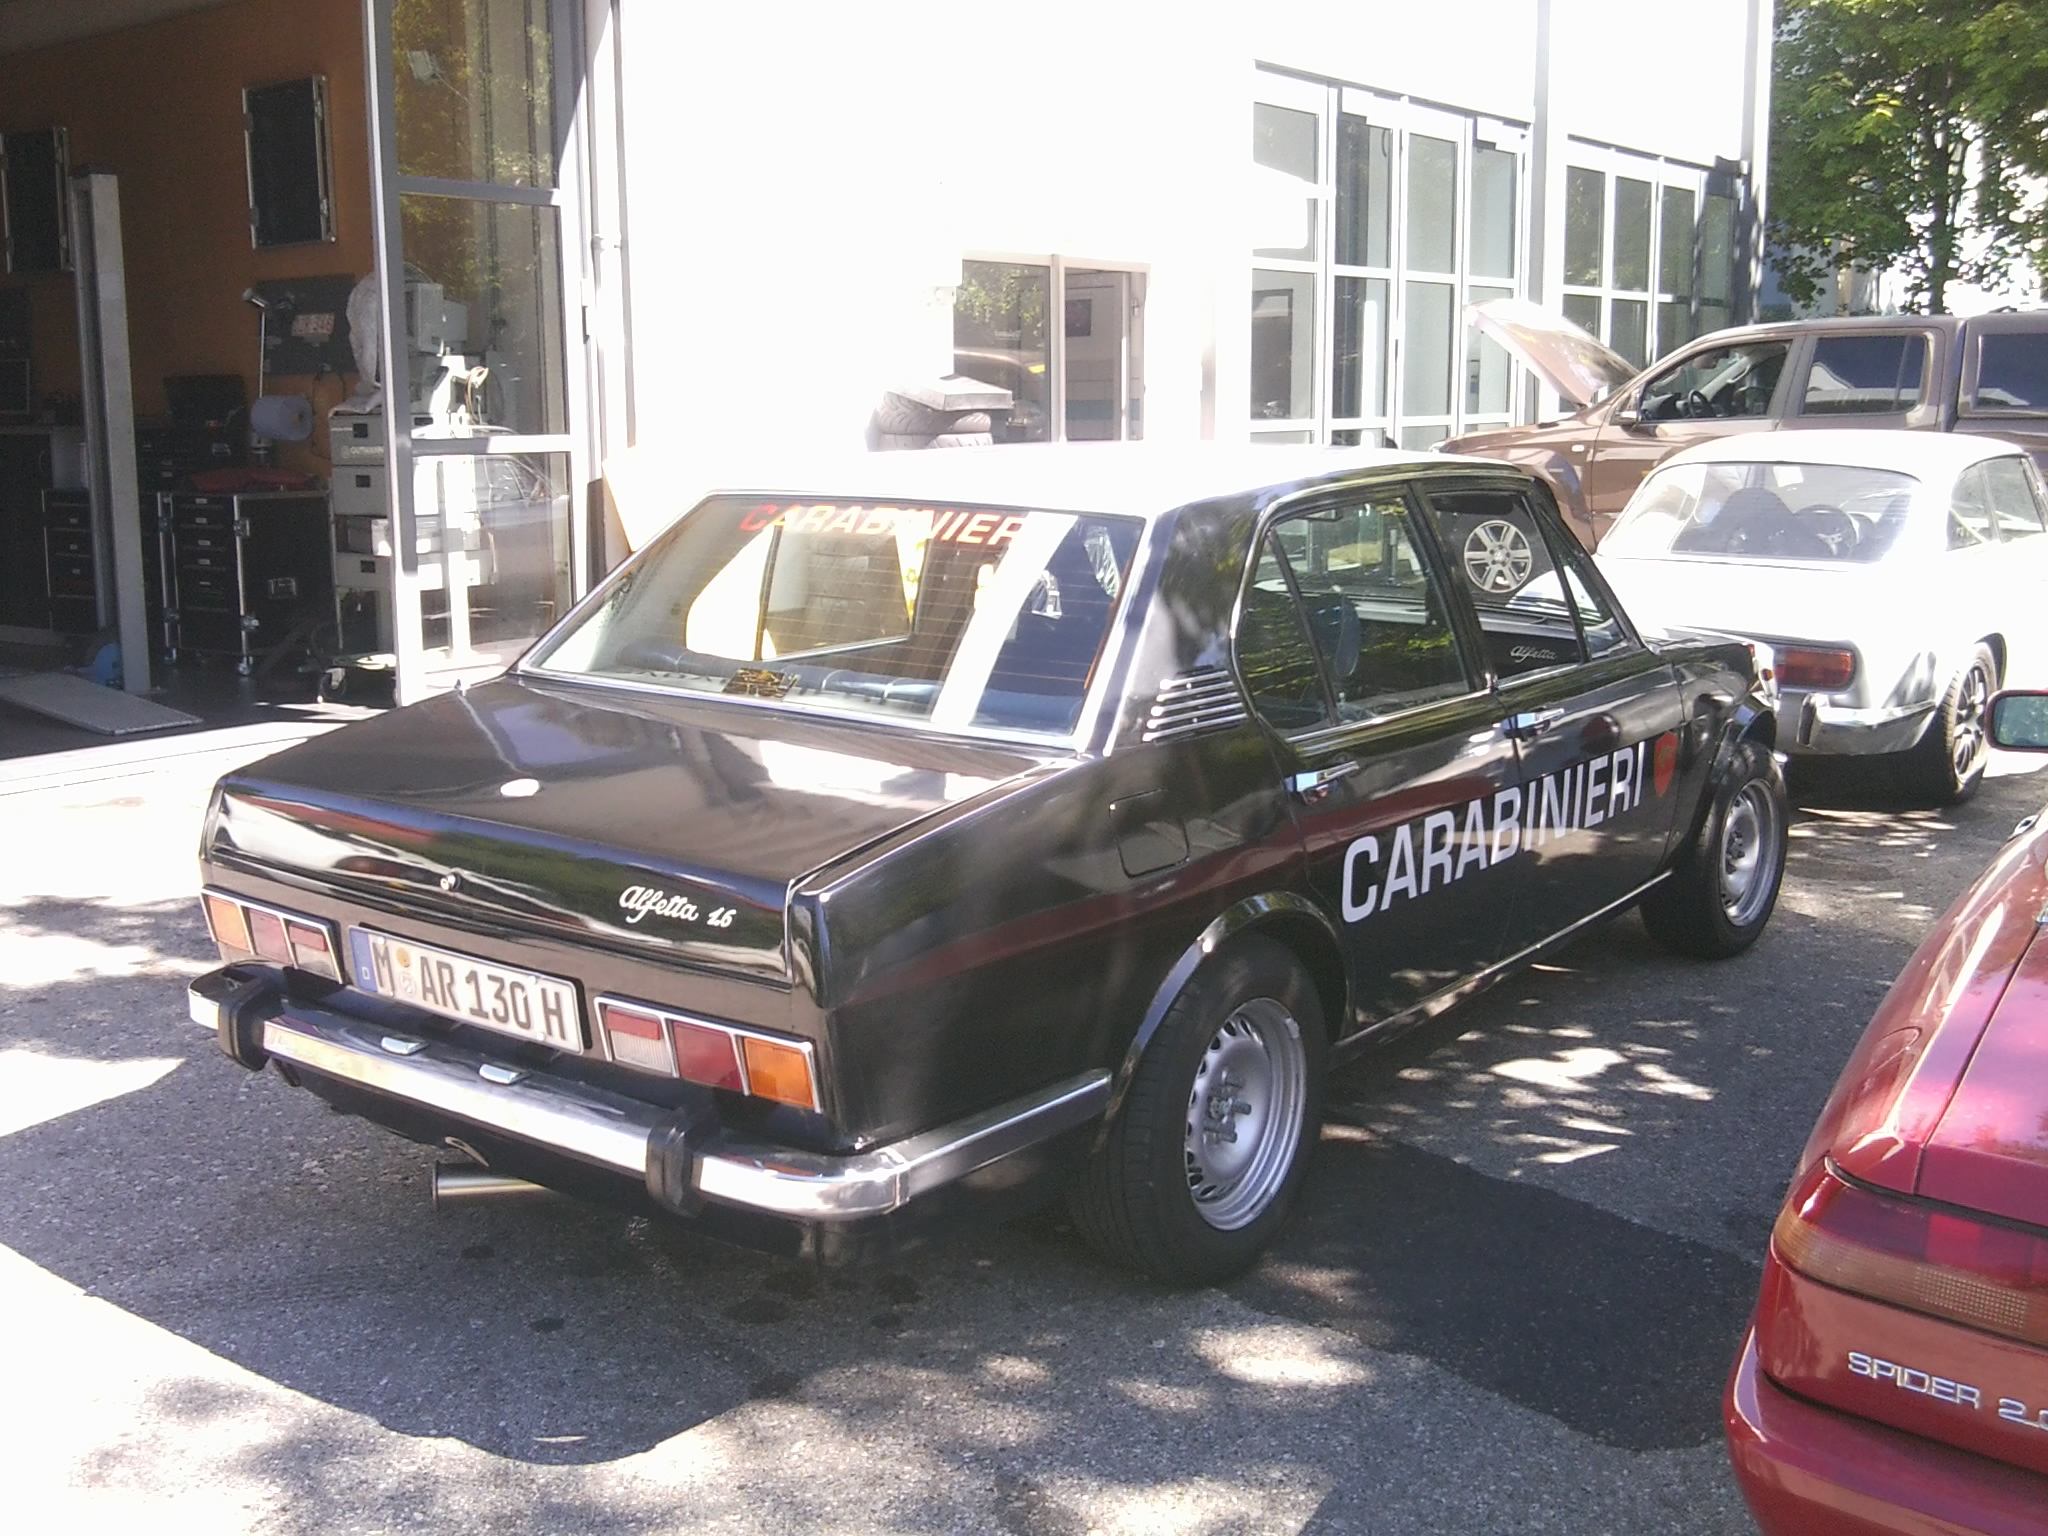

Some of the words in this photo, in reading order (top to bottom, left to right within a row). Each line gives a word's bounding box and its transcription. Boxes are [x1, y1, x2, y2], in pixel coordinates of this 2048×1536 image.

[1510, 645, 1557, 664] Alfetta
[1341, 741, 1646, 923] CARABINIERI
[619, 885, 699, 924] Alfetta
[372, 942, 395, 997] M
[420, 955, 460, 1012] AR
[465, 969, 532, 1030] 130
[543, 986, 567, 1041] H
[1847, 1351, 1980, 1410] SPIDER
